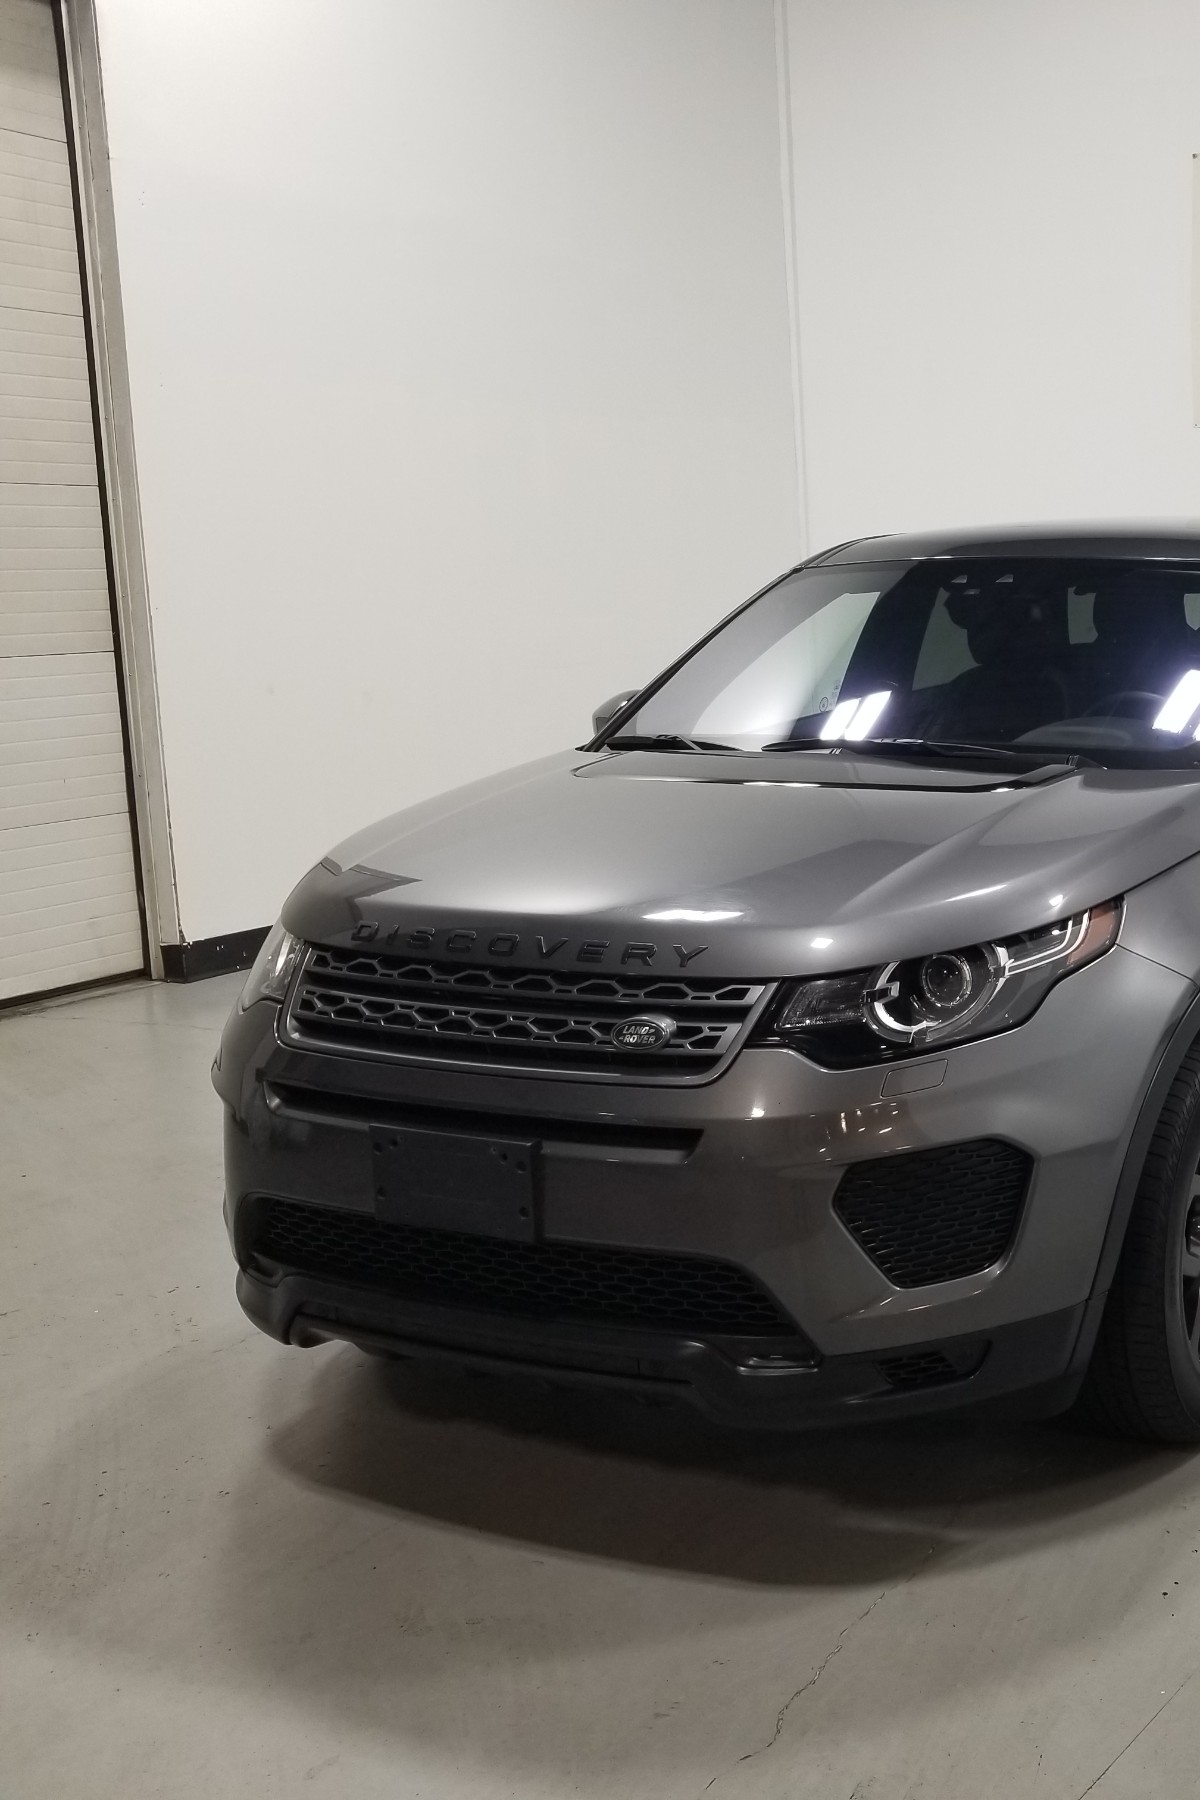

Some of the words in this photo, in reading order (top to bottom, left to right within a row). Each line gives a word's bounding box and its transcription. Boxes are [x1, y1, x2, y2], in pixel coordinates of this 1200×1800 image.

[351, 919, 709, 969] DISCOVERY
[622, 1025, 650, 1035] LAND
[623, 1034, 656, 1043] ROVER
